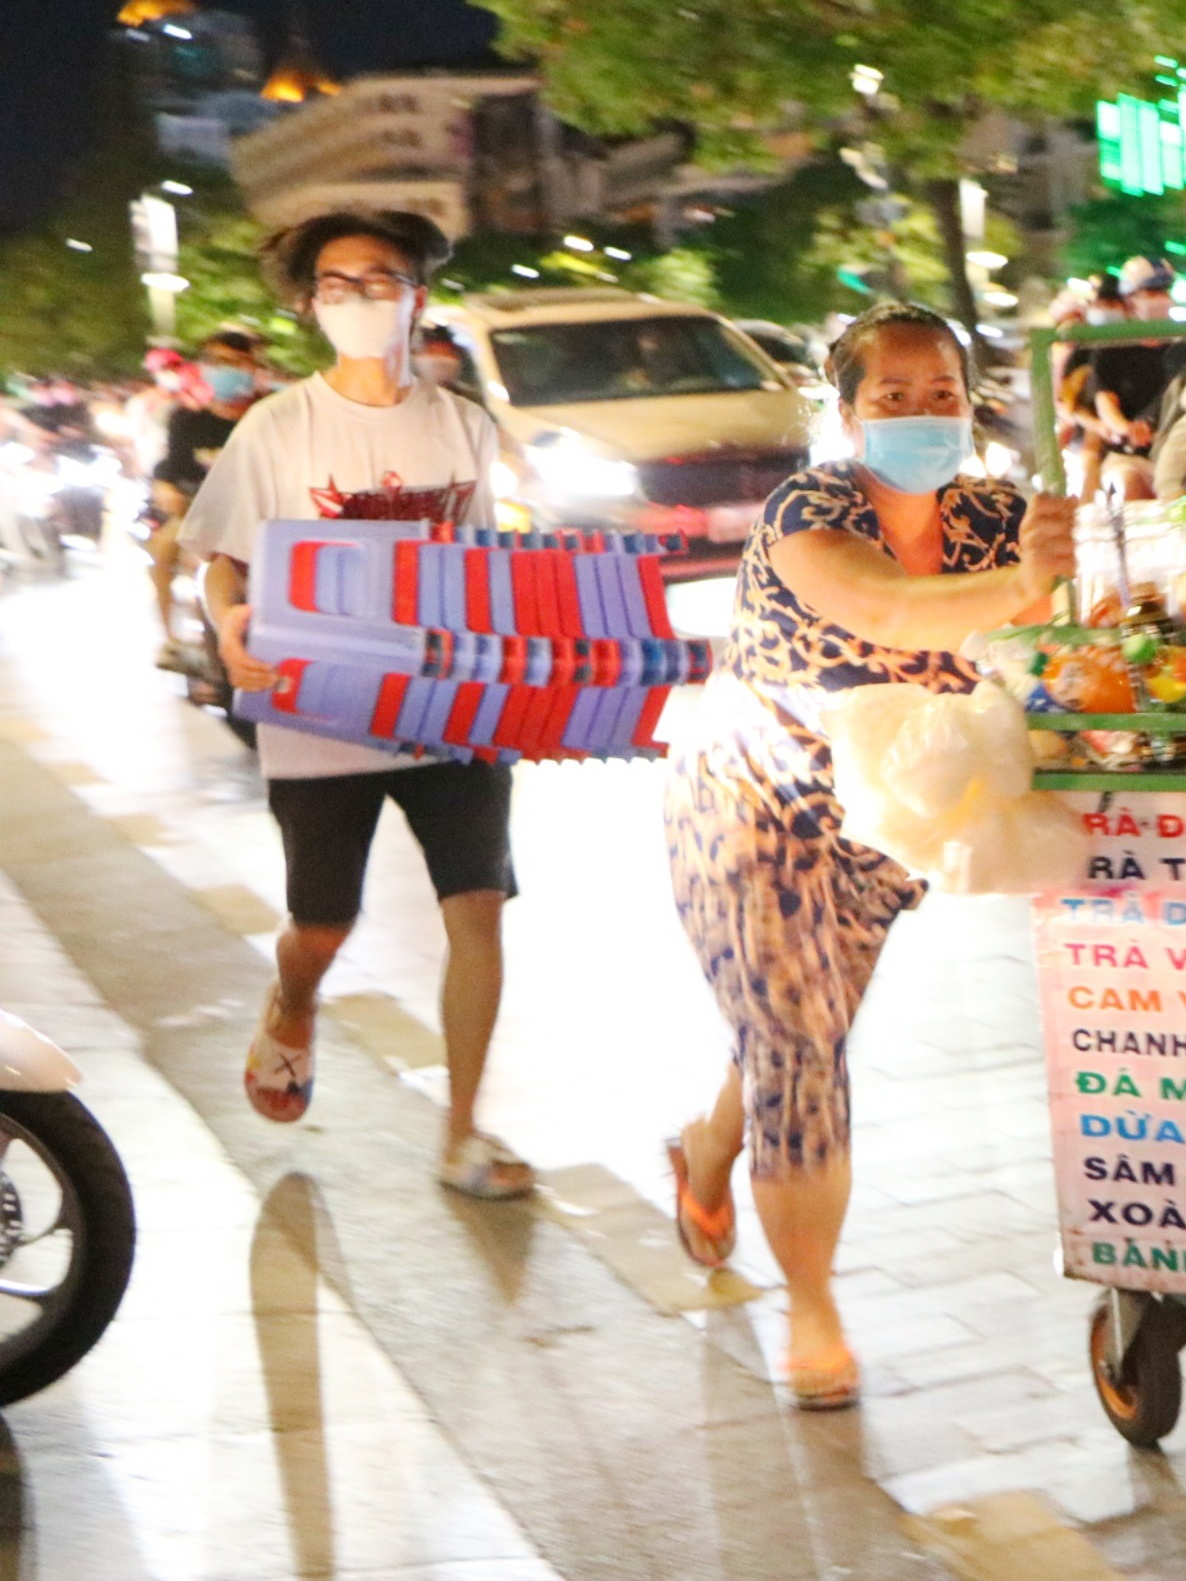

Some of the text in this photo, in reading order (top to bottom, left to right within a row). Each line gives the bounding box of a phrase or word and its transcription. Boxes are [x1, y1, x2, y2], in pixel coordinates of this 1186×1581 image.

[1081, 806, 1141, 837] RÀ
[1086, 850, 1146, 880] RÀ
[1064, 938, 1150, 969] TRÀ
[1067, 985, 1163, 1012] CAM
[1074, 1067, 1142, 1098] ĐÁ
[1080, 1110, 1186, 1145] DỪA
[1083, 1153, 1176, 1187] SÂM
